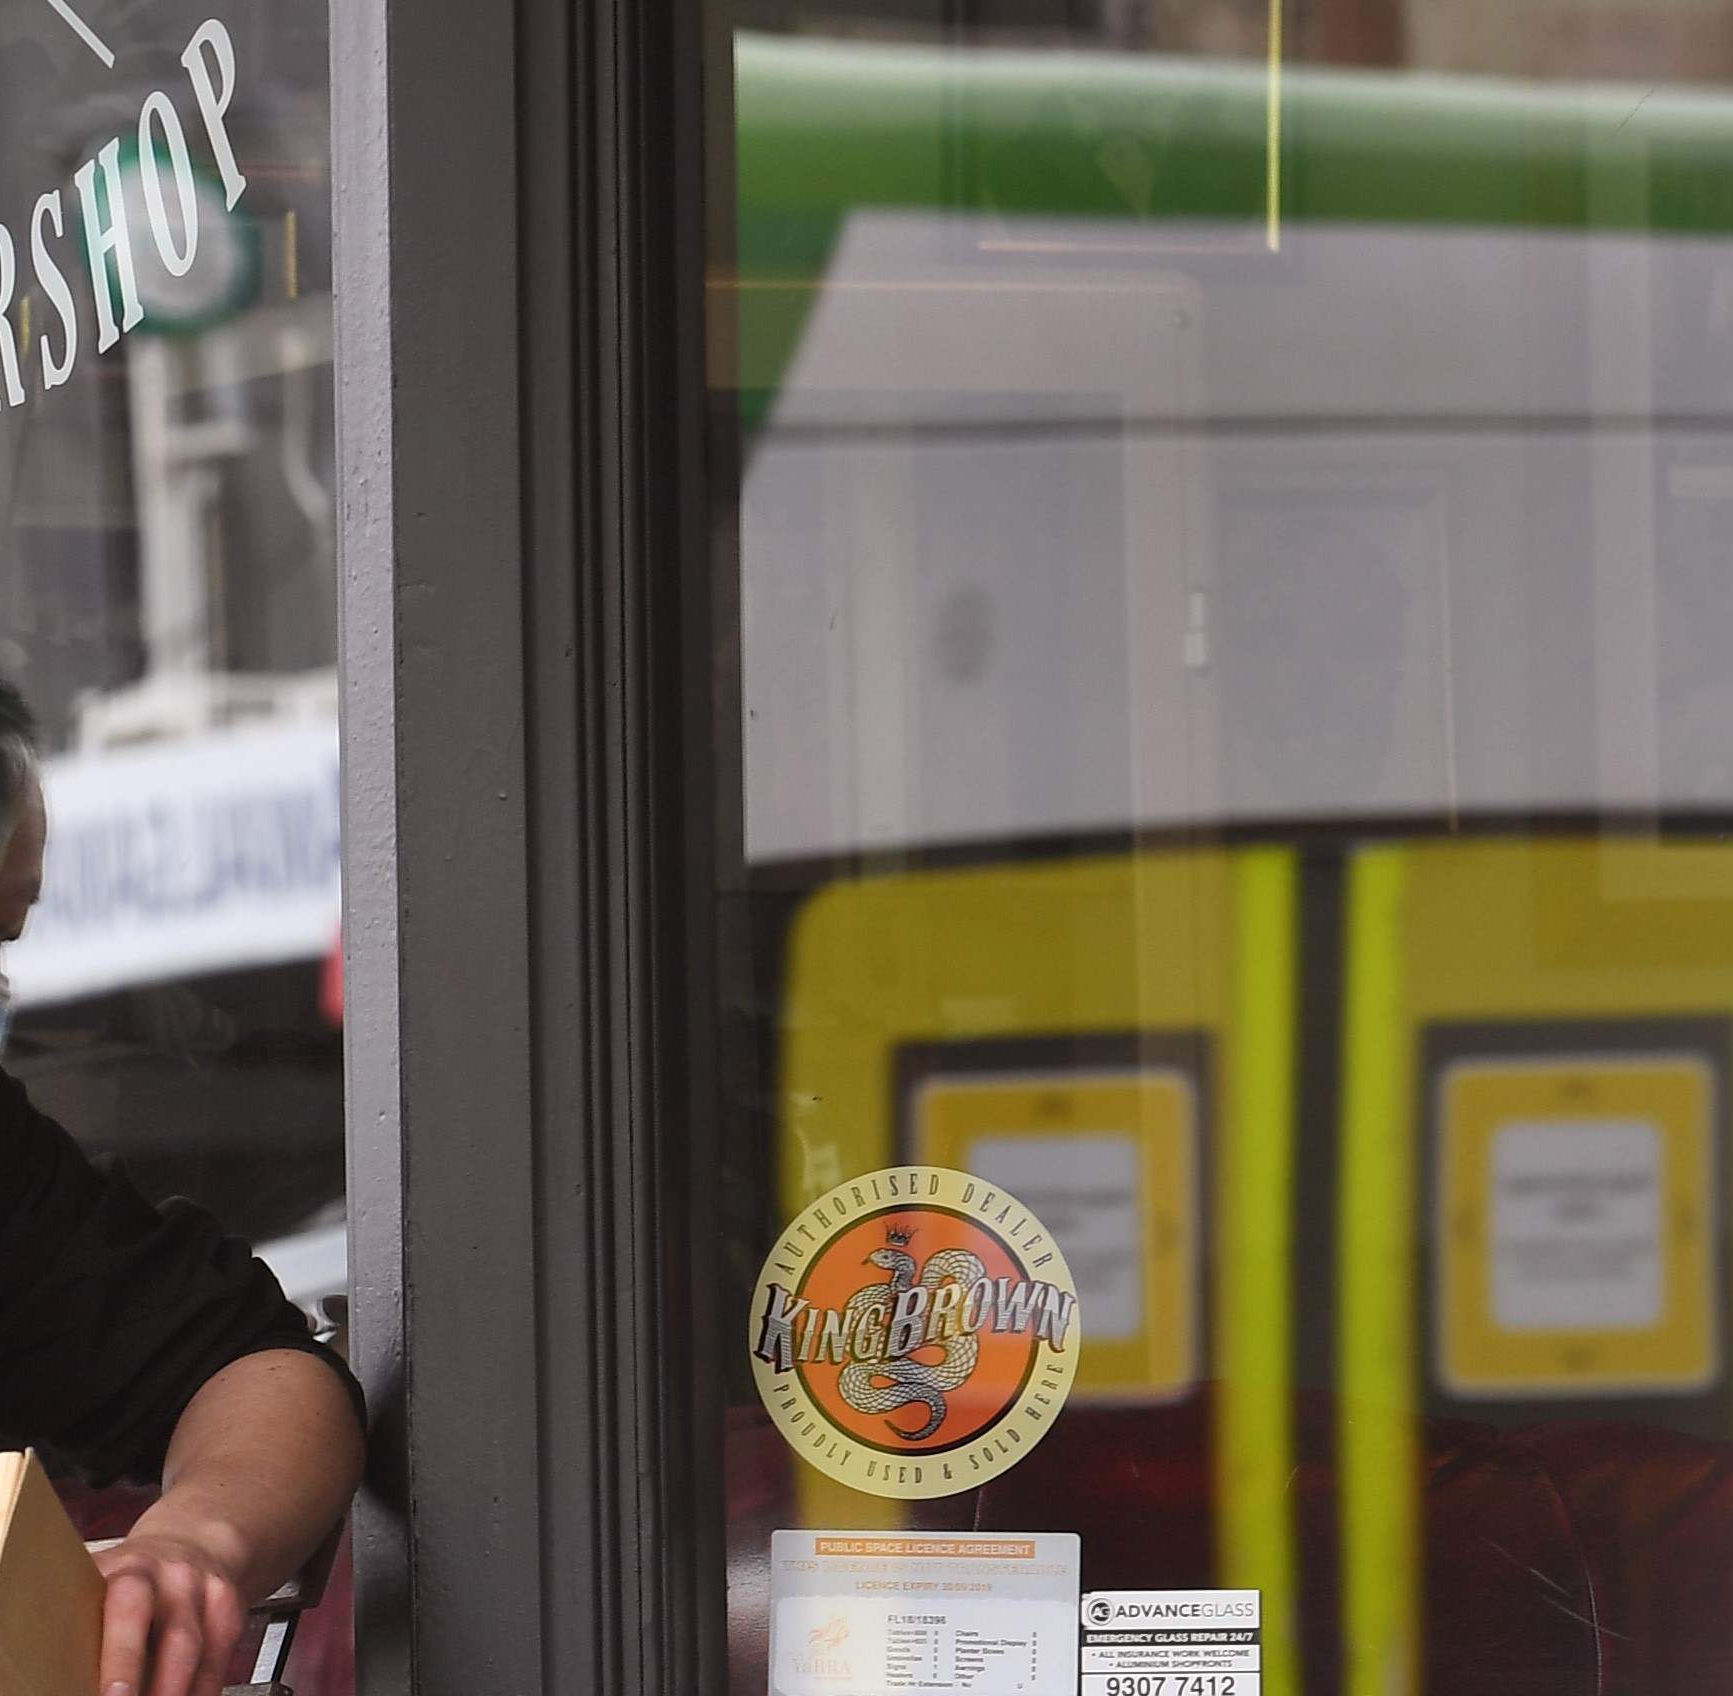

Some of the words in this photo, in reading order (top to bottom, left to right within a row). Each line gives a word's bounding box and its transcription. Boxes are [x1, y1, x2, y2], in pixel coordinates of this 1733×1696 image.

[775, 1173, 940, 1275] AUTHORISED
[961, 1183, 1053, 1268] DEALER
[773, 1384, 851, 1465] PROUDLY
[867, 1464, 922, 1484] USED
[970, 1428, 1021, 1470] SOLD
[1025, 1363, 1063, 1421] HERE
[820, 1542, 863, 1552] PUBLIC
[866, 1542, 902, 1553] SPACE
[905, 1543, 955, 1554] LICENCE
[958, 1543, 1031, 1555] AGREEMENT
[1086, 1633, 1153, 1643] EMERGENCY
[1155, 1633, 1189, 1642] GLASS
[1190, 1632, 1228, 1642] REPAIR
[1230, 1632, 1253, 1642] 24/7
[1172, 1650, 1202, 1658] WORK
[1203, 1649, 1250, 1657] WELCOME
[1106, 1676, 1166, 1696] 9307
[1174, 1676, 1235, 1696] 7412
